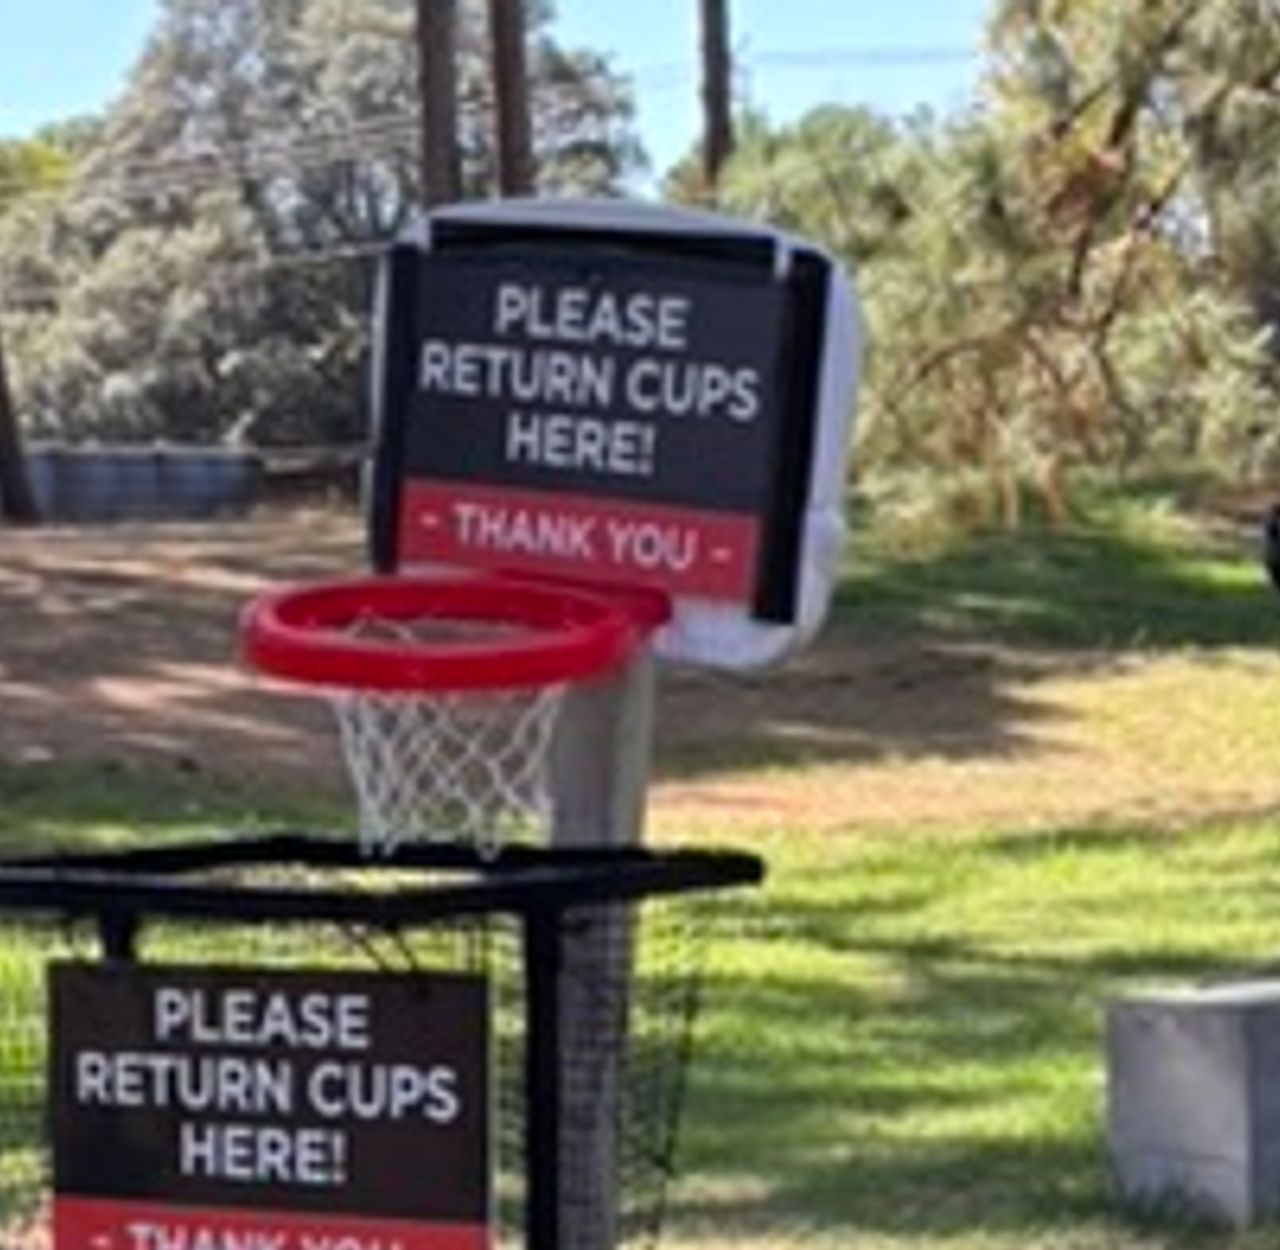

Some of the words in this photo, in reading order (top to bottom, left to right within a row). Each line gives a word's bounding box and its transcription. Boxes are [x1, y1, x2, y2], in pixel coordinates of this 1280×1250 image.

[494, 285, 691, 349] PLEASE
[421, 341, 616, 407] RETURN
[626, 358, 760, 420] CUPS
[505, 412, 656, 475] HERE!
[454, 503, 593, 560] THANK
[605, 523, 697, 571] YOU
[154, 987, 370, 1049] PLEASE
[76, 1051, 292, 1115] RETURN
[308, 1063, 459, 1123] CUPS
[180, 1122, 348, 1184] HERE!
